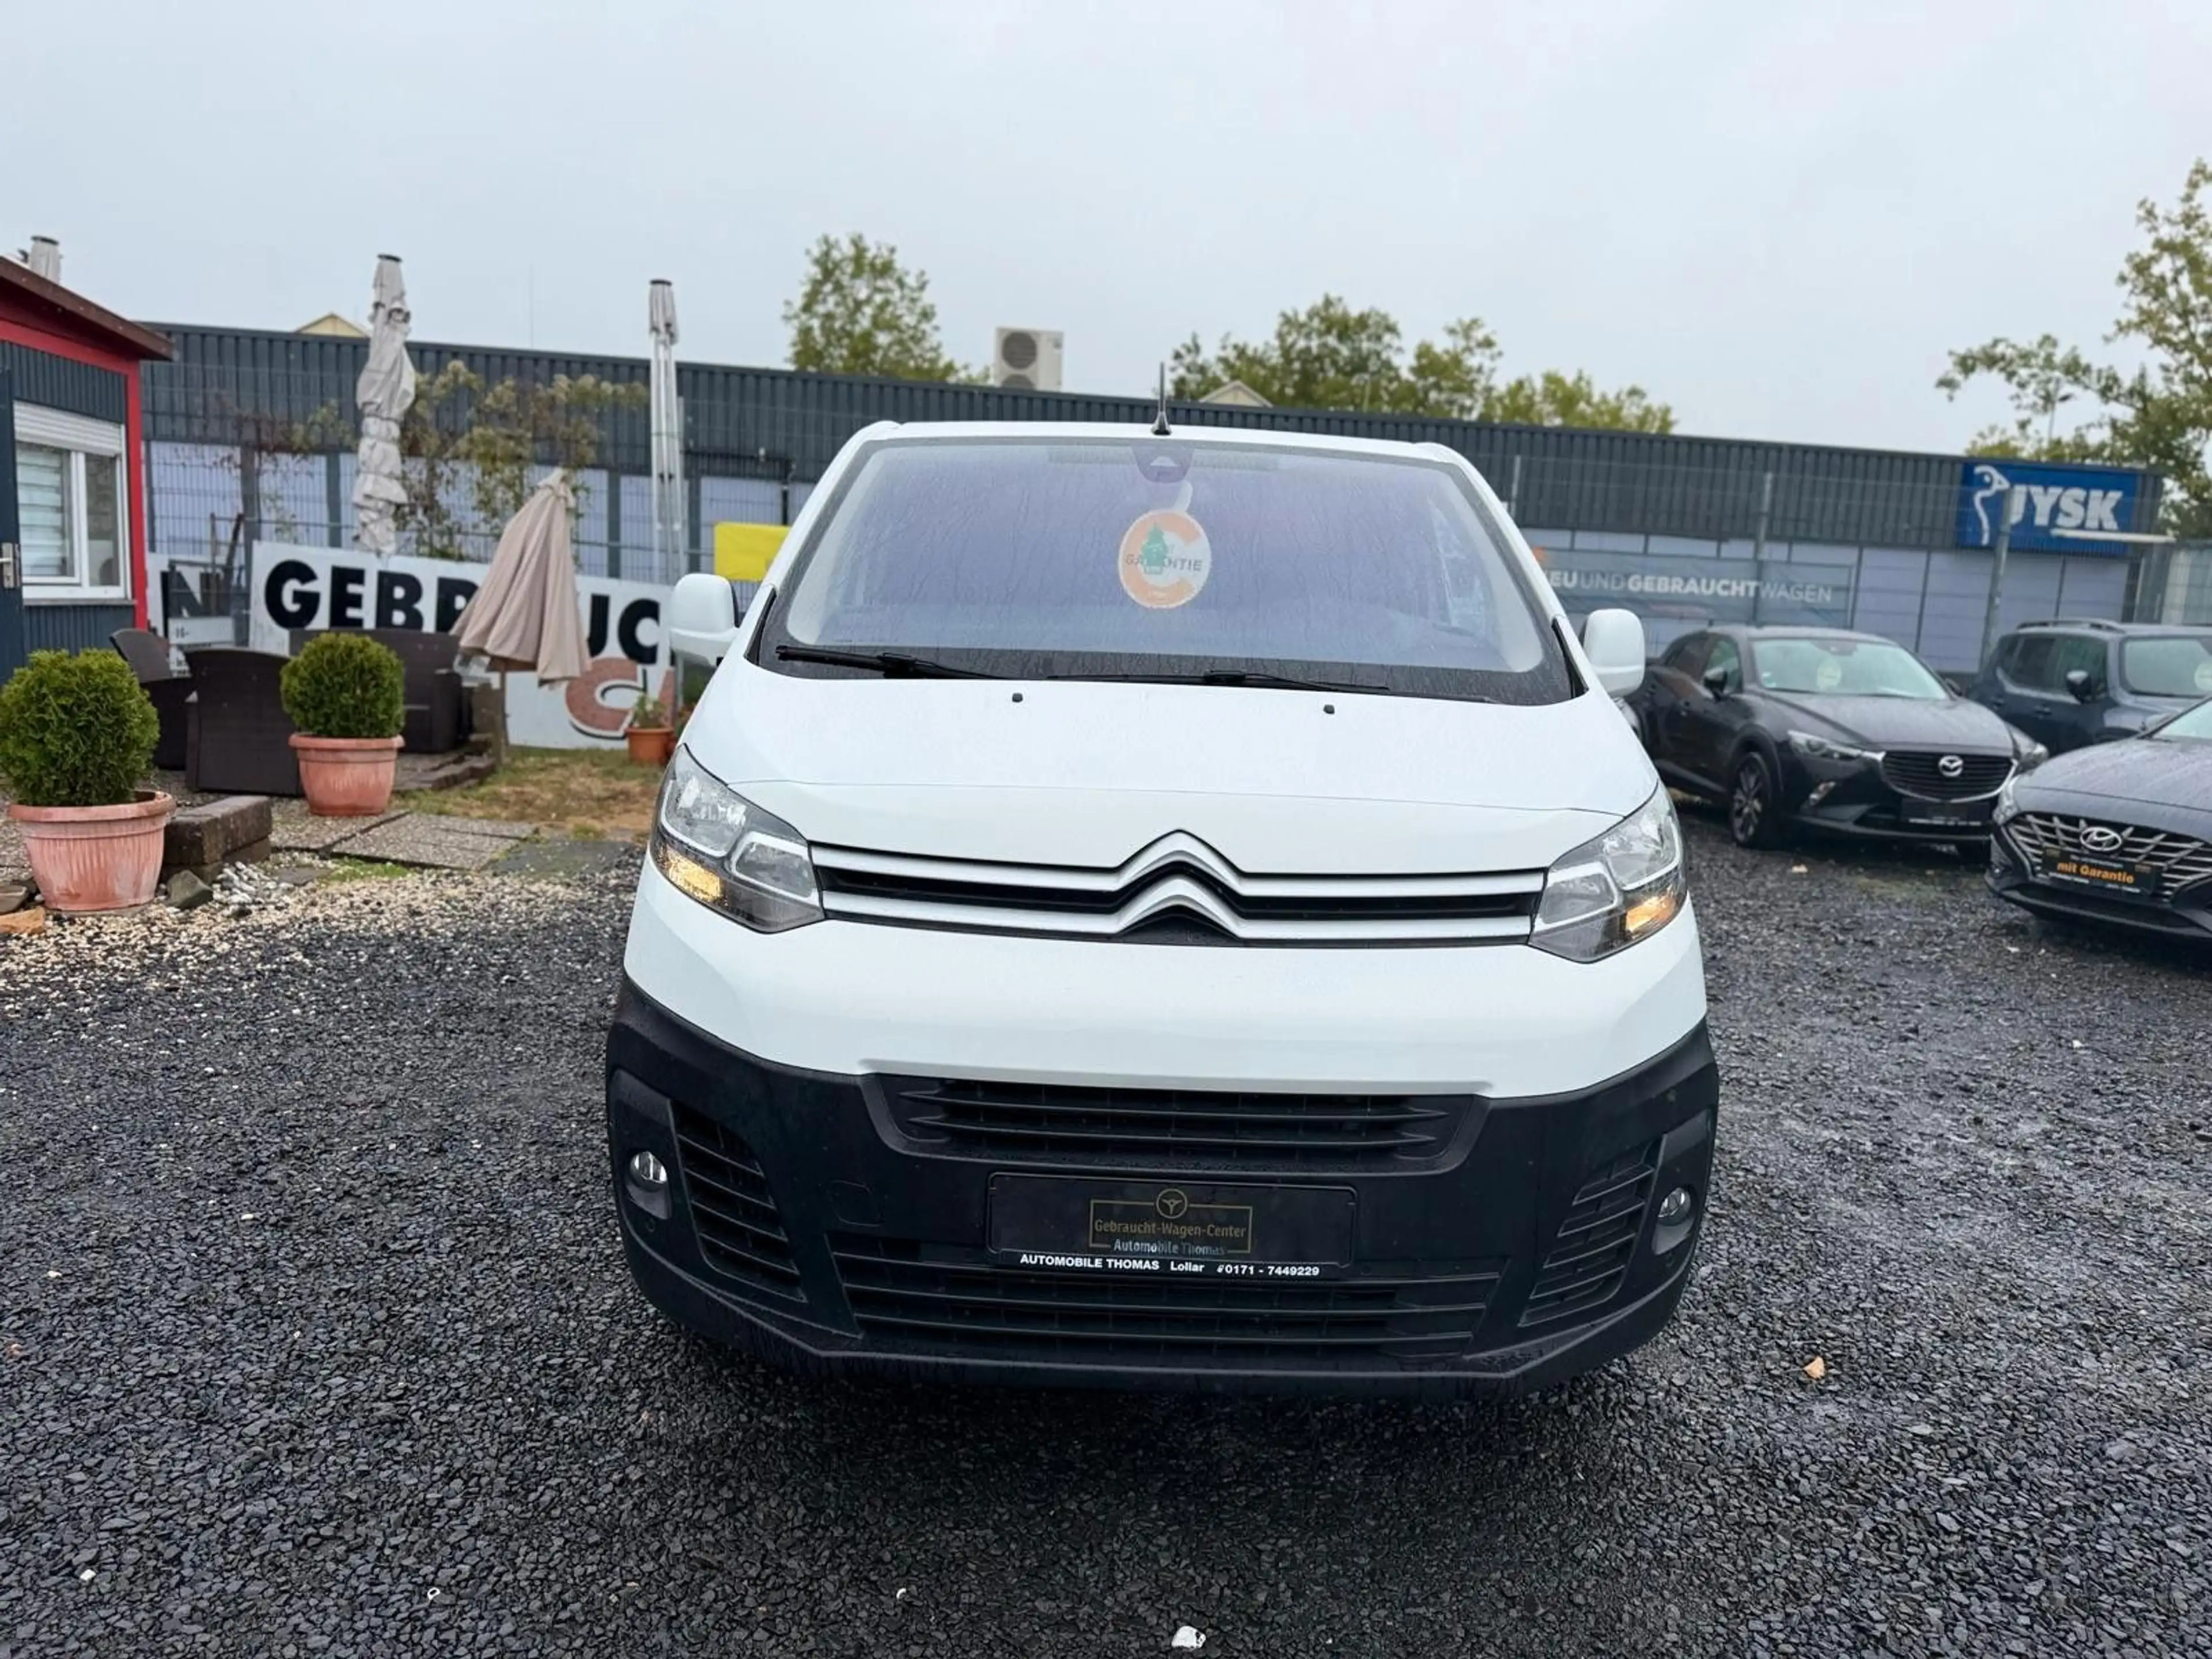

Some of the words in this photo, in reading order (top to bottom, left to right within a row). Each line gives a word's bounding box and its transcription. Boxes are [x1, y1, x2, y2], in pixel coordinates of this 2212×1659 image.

[2010, 484, 2123, 529] JYSK
[2056, 862, 2077, 874] mit
[1094, 1219, 1247, 1238] Gebraucht-Wagen-Center
[1113, 1239, 1179, 1253] Automobile
[1181, 1242, 1225, 1255] Thomas
[1020, 1254, 1103, 1268] AUTOMOBILE
[1105, 1258, 1160, 1271] THOMAS
[1170, 1260, 1205, 1272] Lollar
[1268, 1266, 1320, 1277] 7449229
